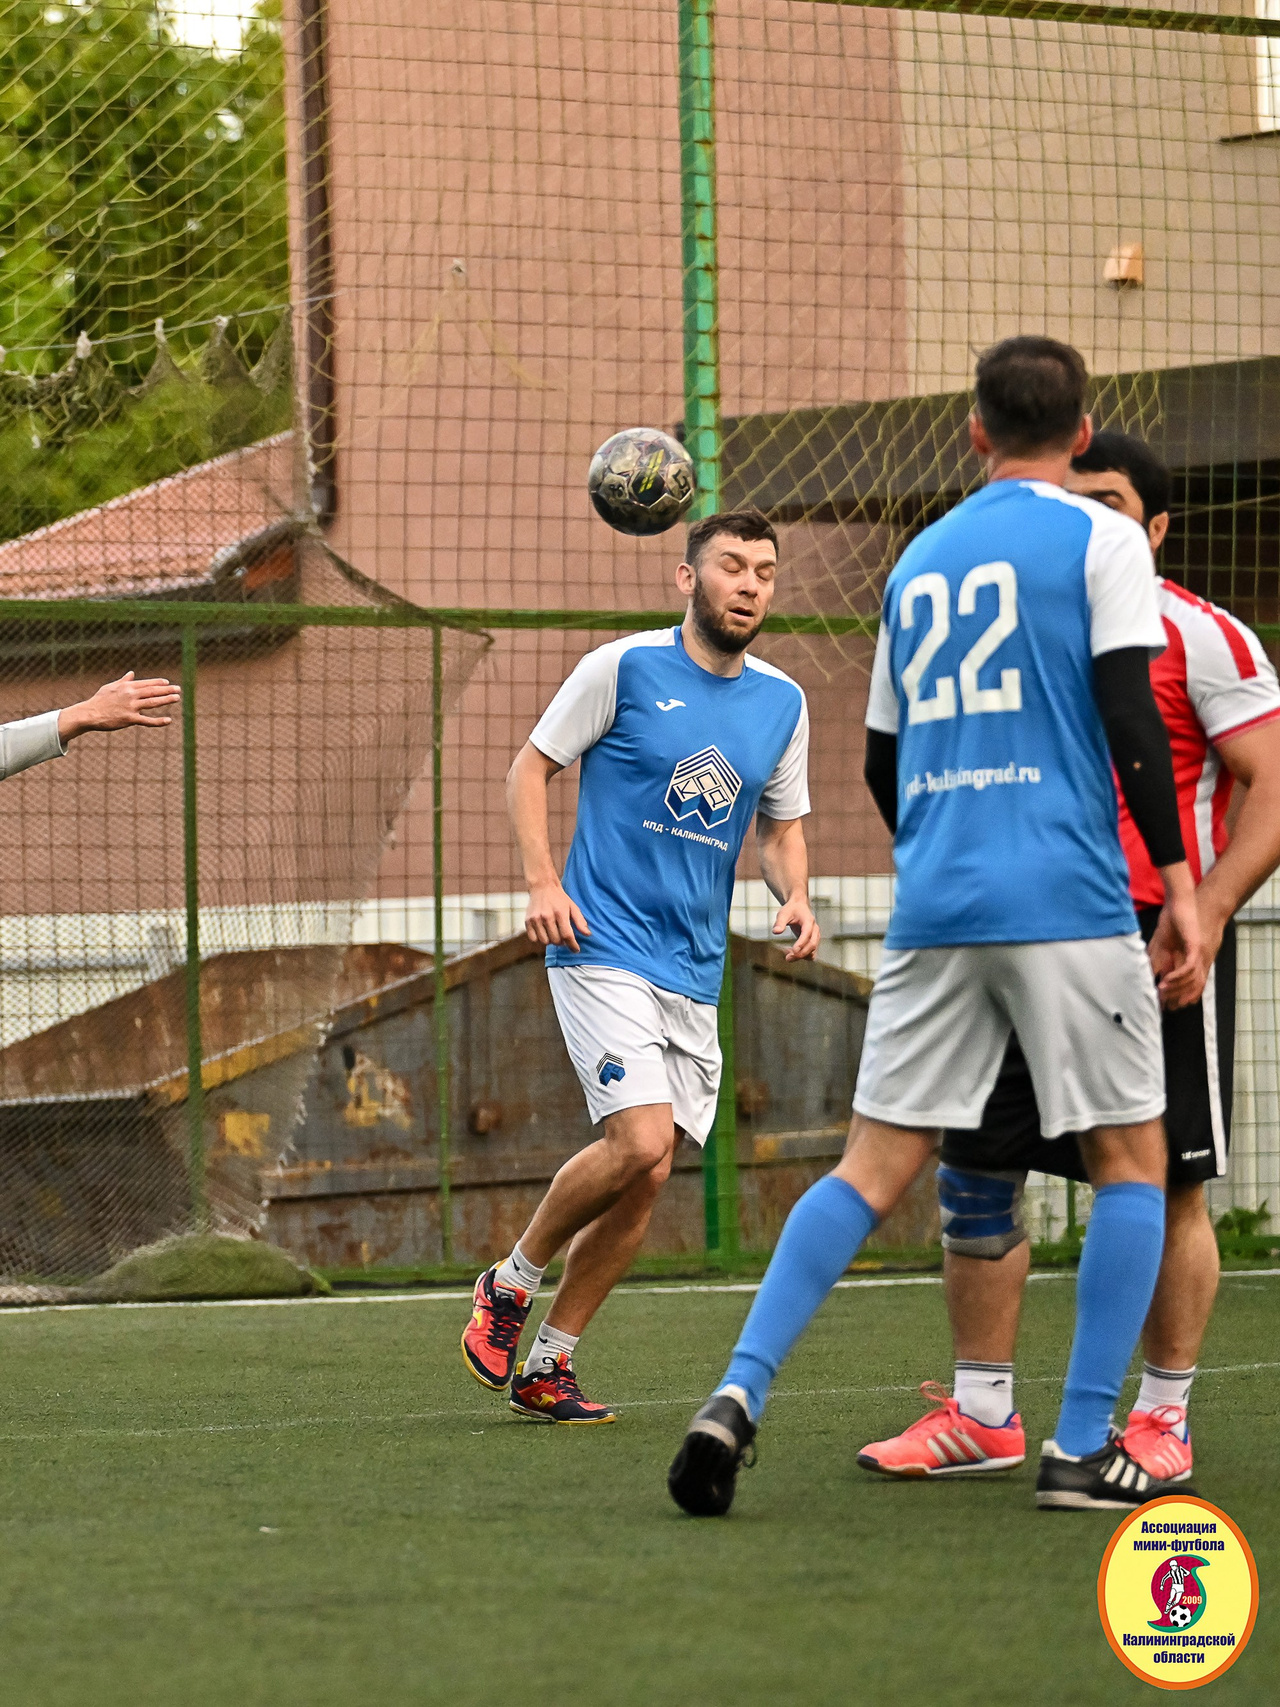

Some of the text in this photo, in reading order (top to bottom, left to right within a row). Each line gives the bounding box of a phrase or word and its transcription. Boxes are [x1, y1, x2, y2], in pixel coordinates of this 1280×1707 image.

[900, 561, 1022, 726] 22
[642, 819, 664, 833] КПД
[670, 827, 729, 851] КАЛИНИНГРАД
